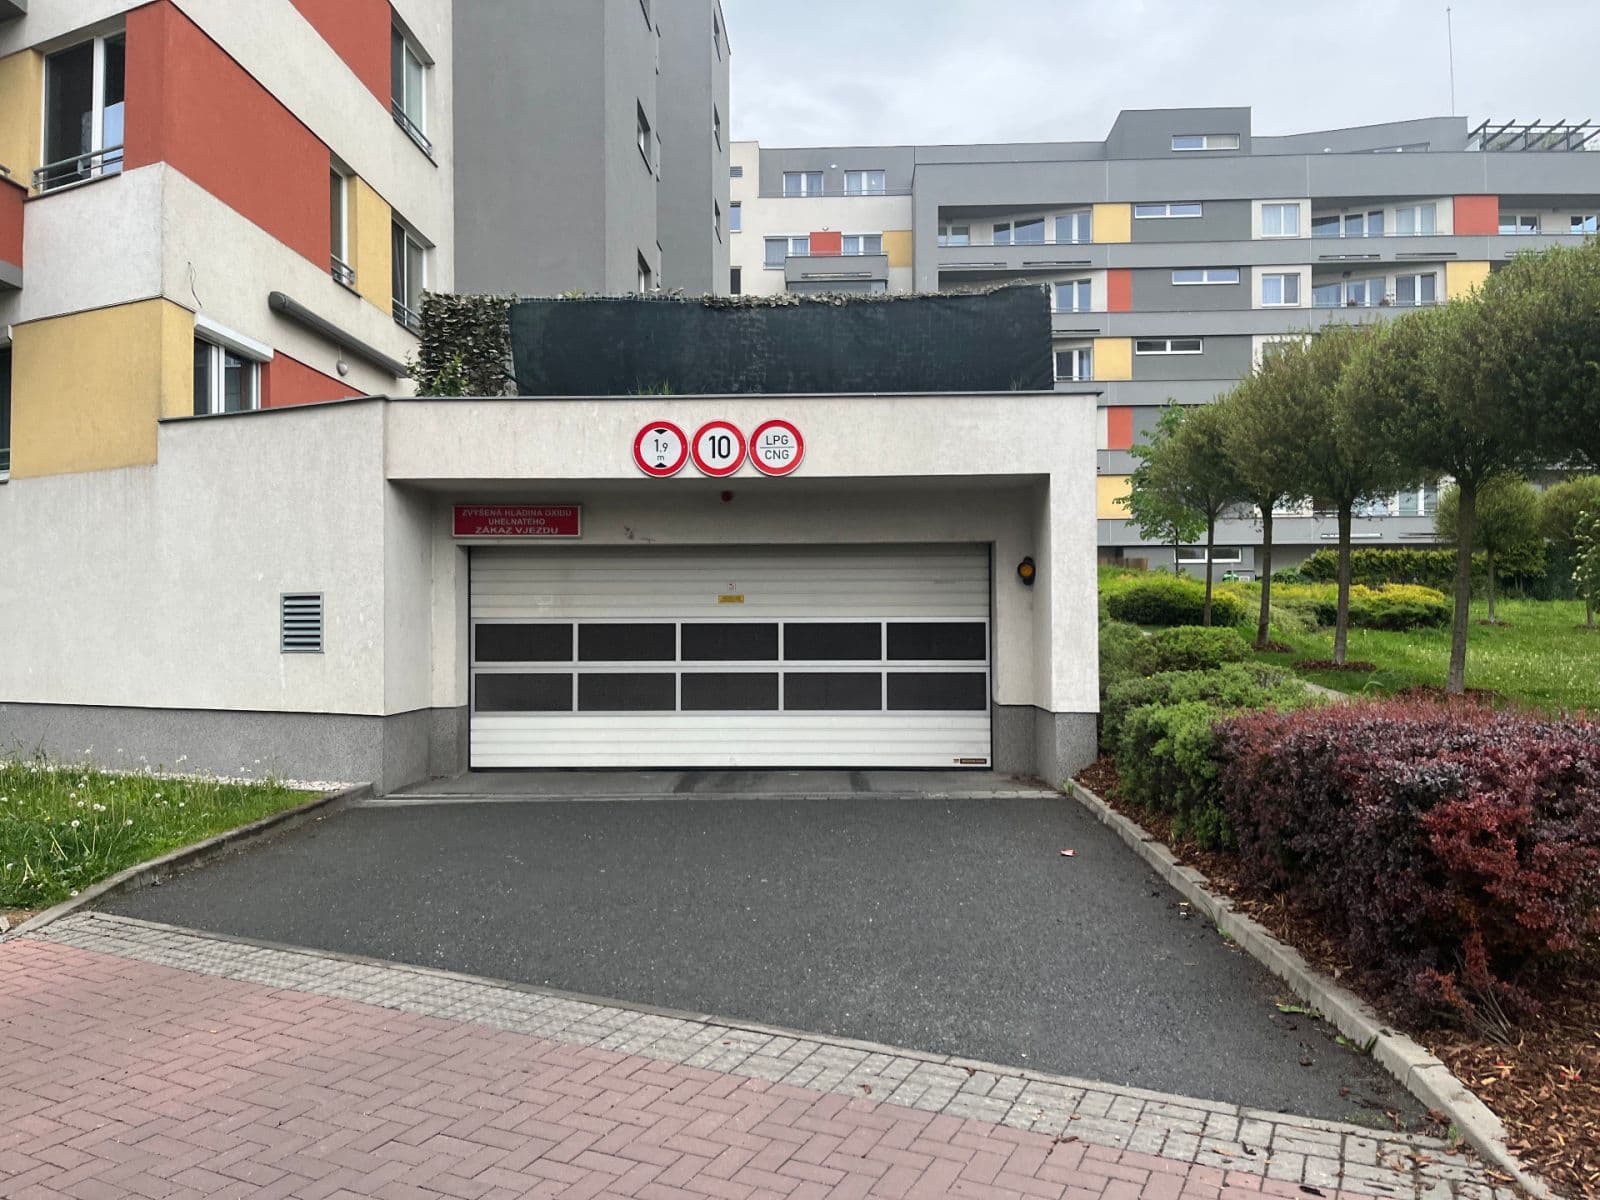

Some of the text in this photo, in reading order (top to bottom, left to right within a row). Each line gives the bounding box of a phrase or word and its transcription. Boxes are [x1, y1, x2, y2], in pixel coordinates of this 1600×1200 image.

[765, 434, 789, 445] LPG
[708, 435, 731, 459] 10
[764, 449, 790, 460] CNG
[514, 526, 559, 534] VJEZDU
